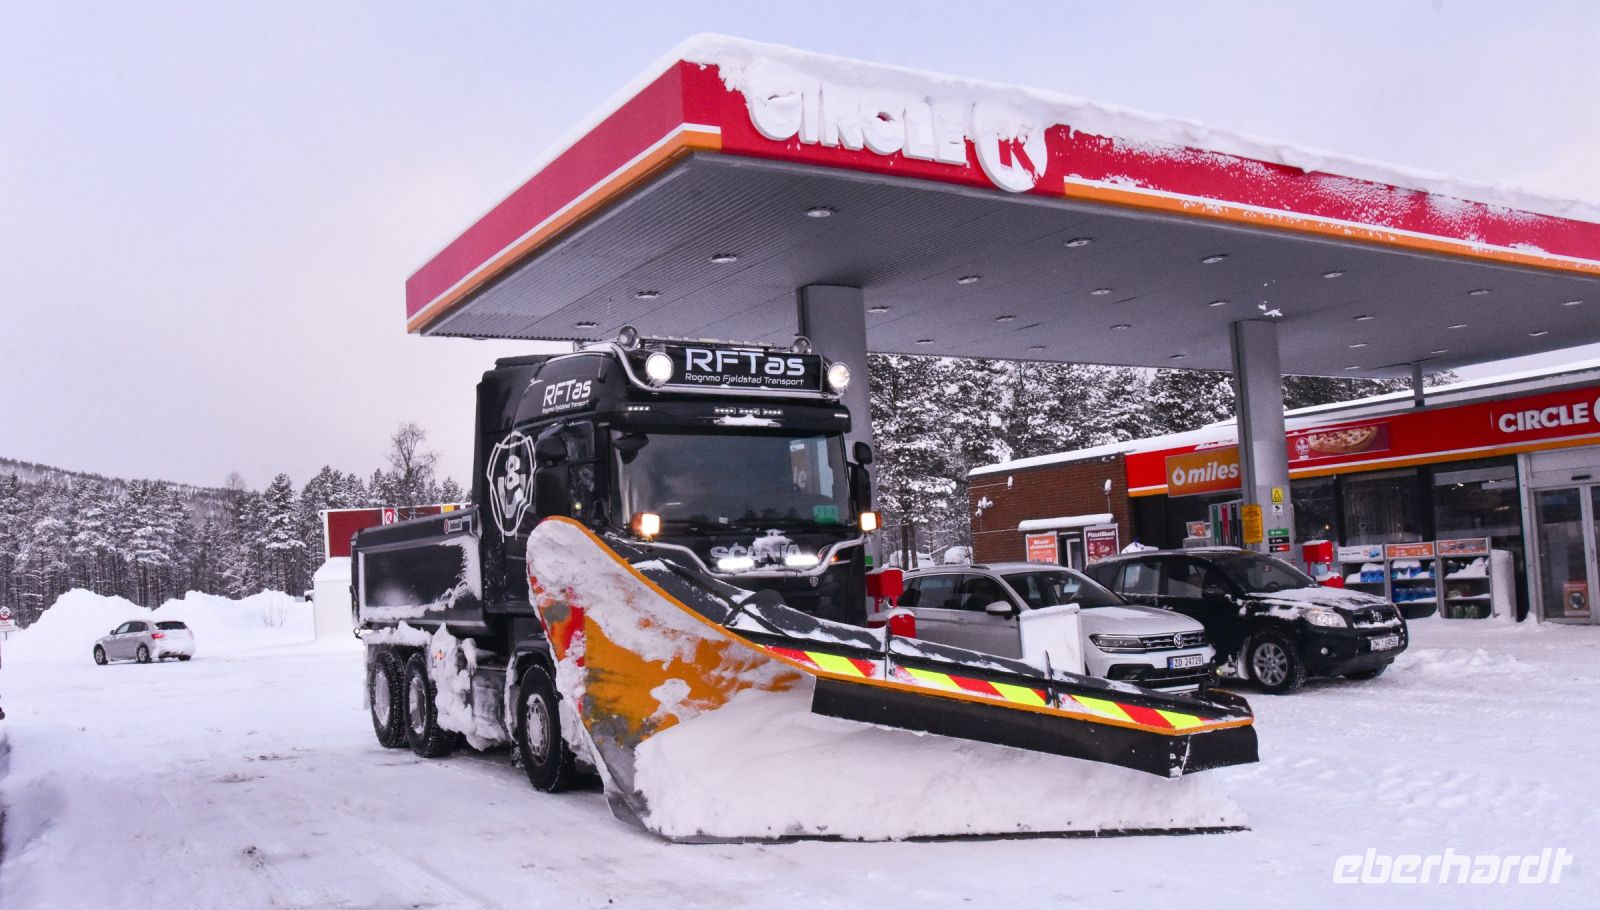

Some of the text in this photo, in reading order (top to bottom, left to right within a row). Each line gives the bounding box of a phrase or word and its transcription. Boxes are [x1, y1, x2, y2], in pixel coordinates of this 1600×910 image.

[750, 92, 968, 165] CIRCLE
[685, 348, 805, 376] RFTas
[685, 372, 805, 386] Rognmo Fjeldstad Transport
[543, 379, 592, 407] RFTas
[1498, 402, 1590, 433] CIRCLE
[1187, 462, 1239, 484] miles
[710, 544, 801, 562] SCANIA
[1174, 658, 1183, 668] ZD
